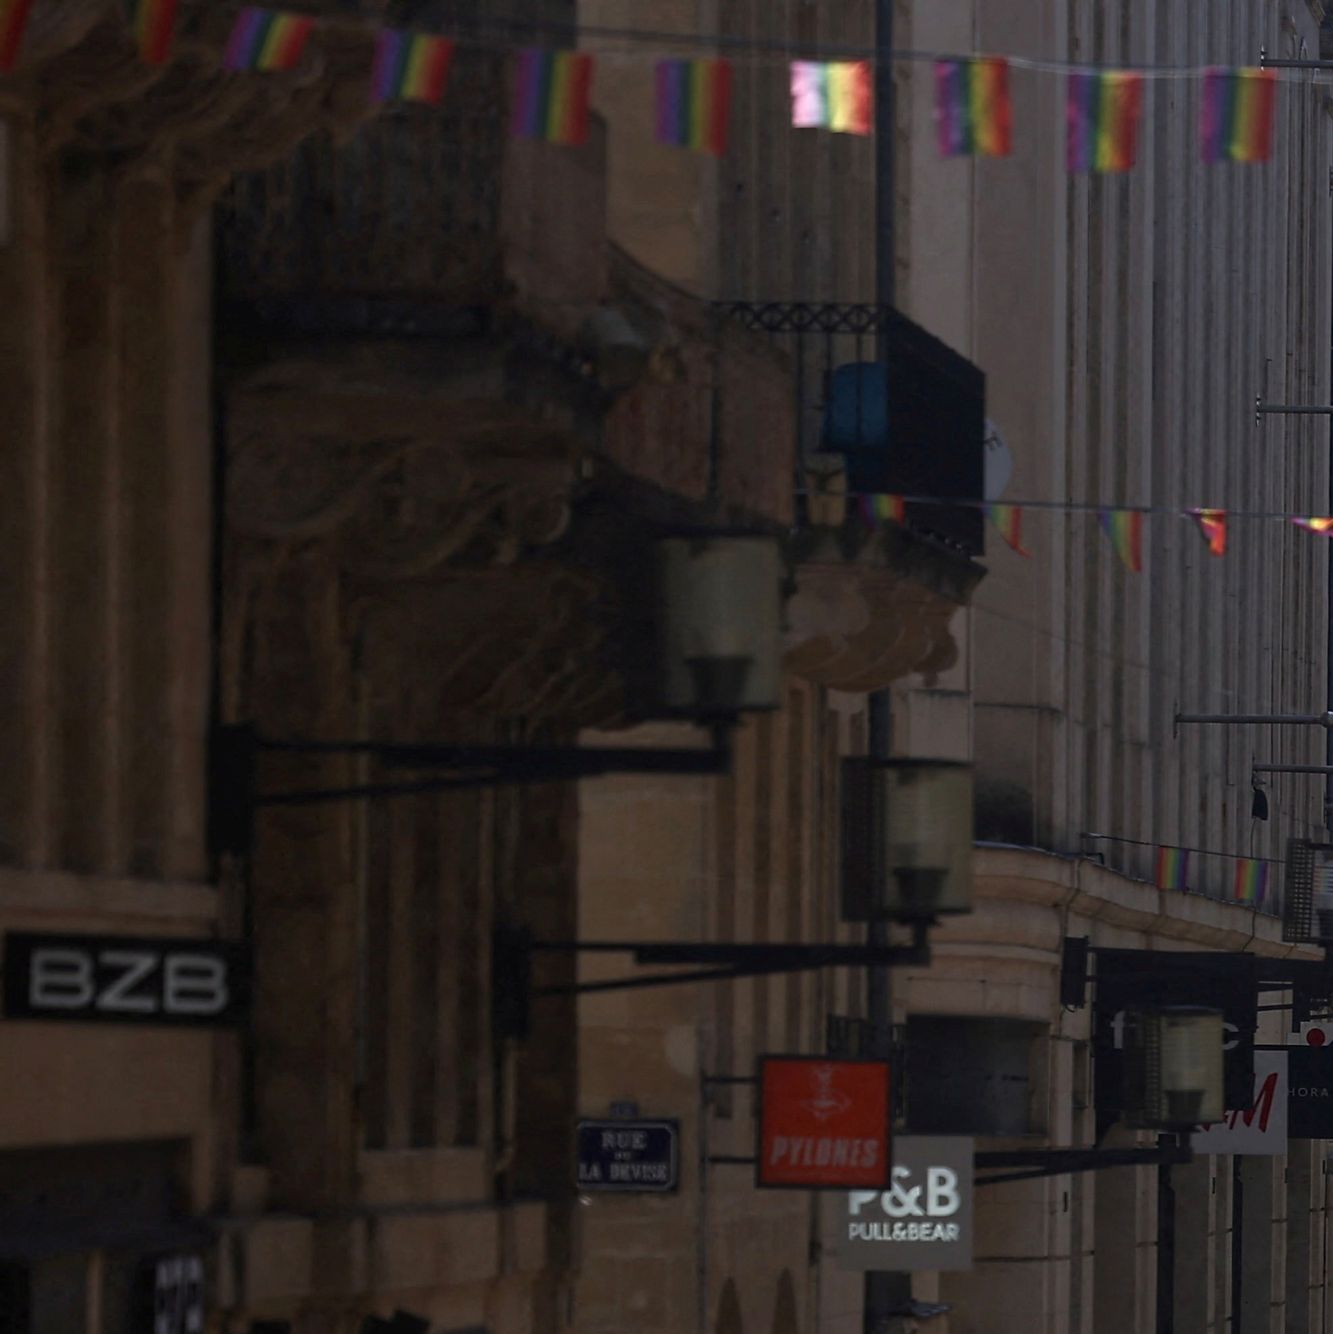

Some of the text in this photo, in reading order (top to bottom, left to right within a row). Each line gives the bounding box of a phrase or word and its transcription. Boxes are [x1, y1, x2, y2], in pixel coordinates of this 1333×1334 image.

[28, 944, 229, 1016] BZB
[601, 1130, 648, 1150] RUE
[769, 1136, 880, 1168] PYLONES
[579, 1161, 667, 1181] LA DEVISE
[849, 1222, 959, 1242] PULL&BEAR
